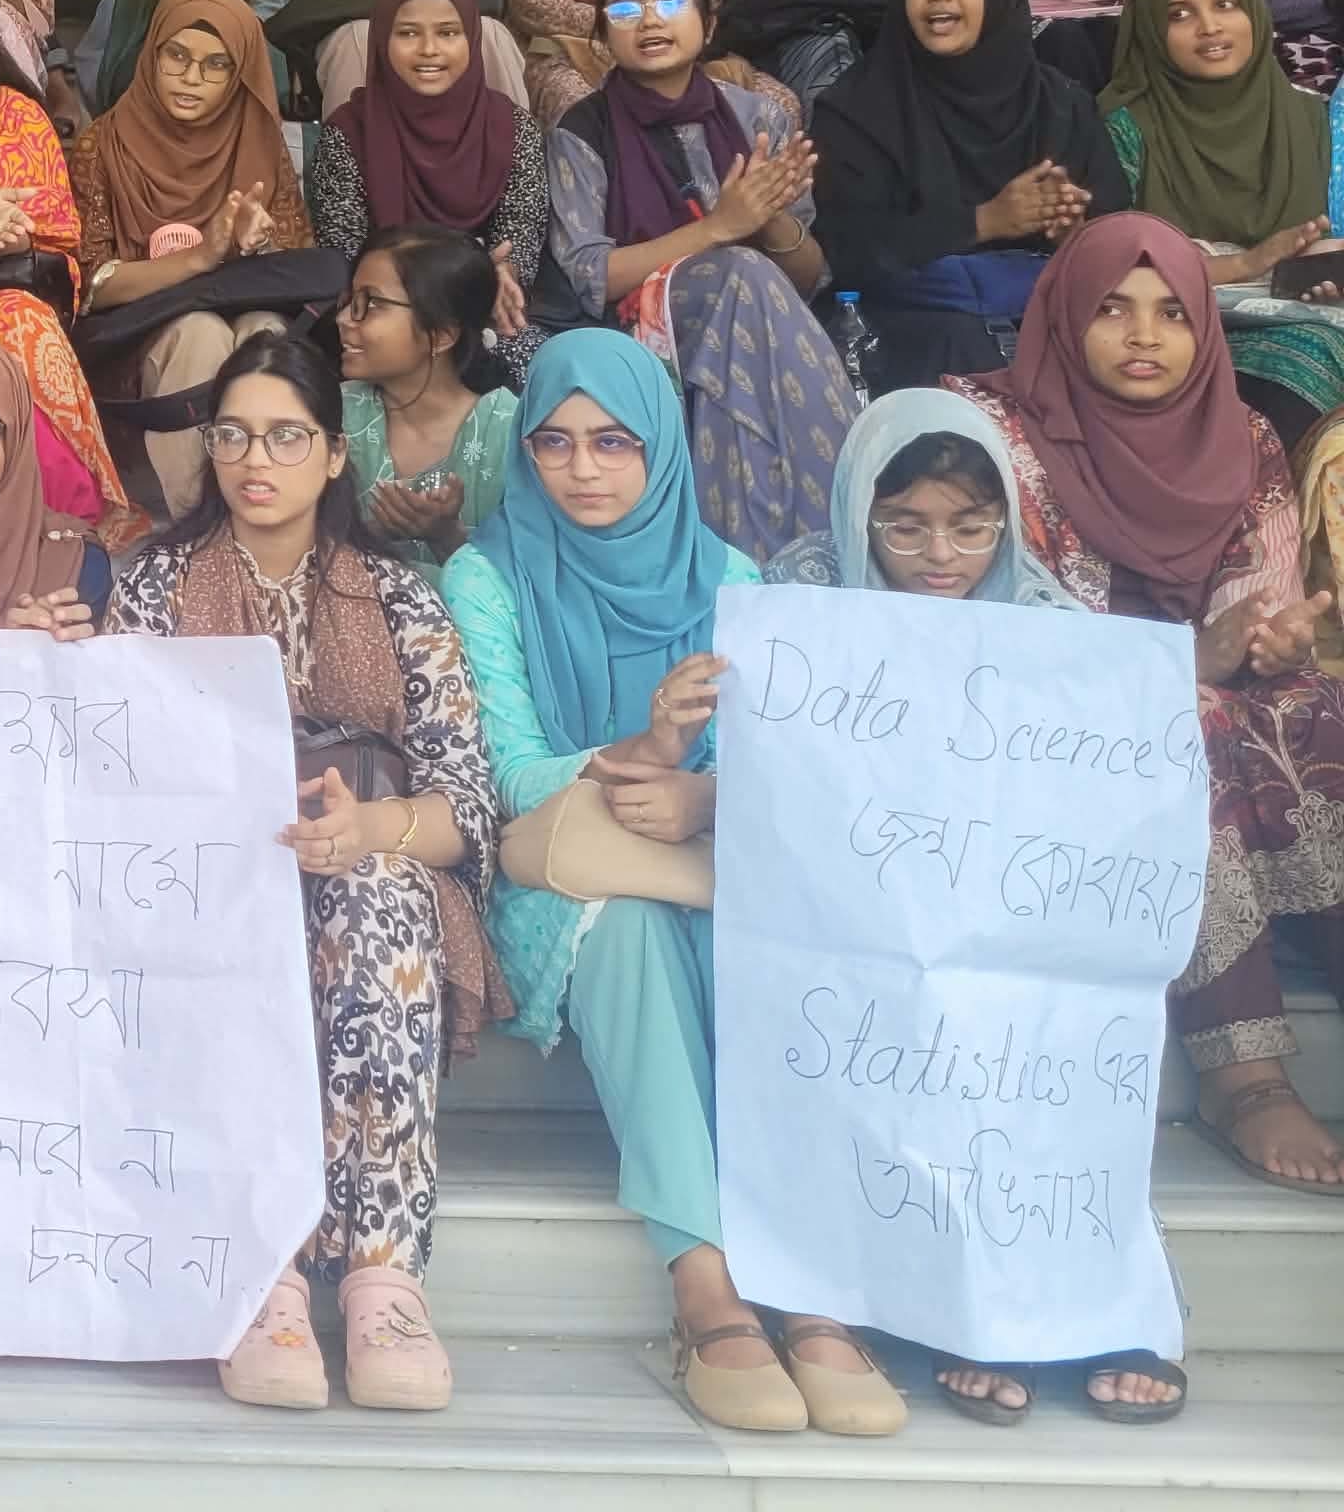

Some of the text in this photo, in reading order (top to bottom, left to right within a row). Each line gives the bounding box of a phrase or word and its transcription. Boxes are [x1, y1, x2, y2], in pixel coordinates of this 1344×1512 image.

[749, 637, 907, 743] Data
[944, 664, 1156, 781] Science
[52, 838, 242, 921] নামে
[785, 986, 1078, 1109] Statistics
[118, 1126, 176, 1194] না
[28, 1223, 231, 1299] চলবে না
